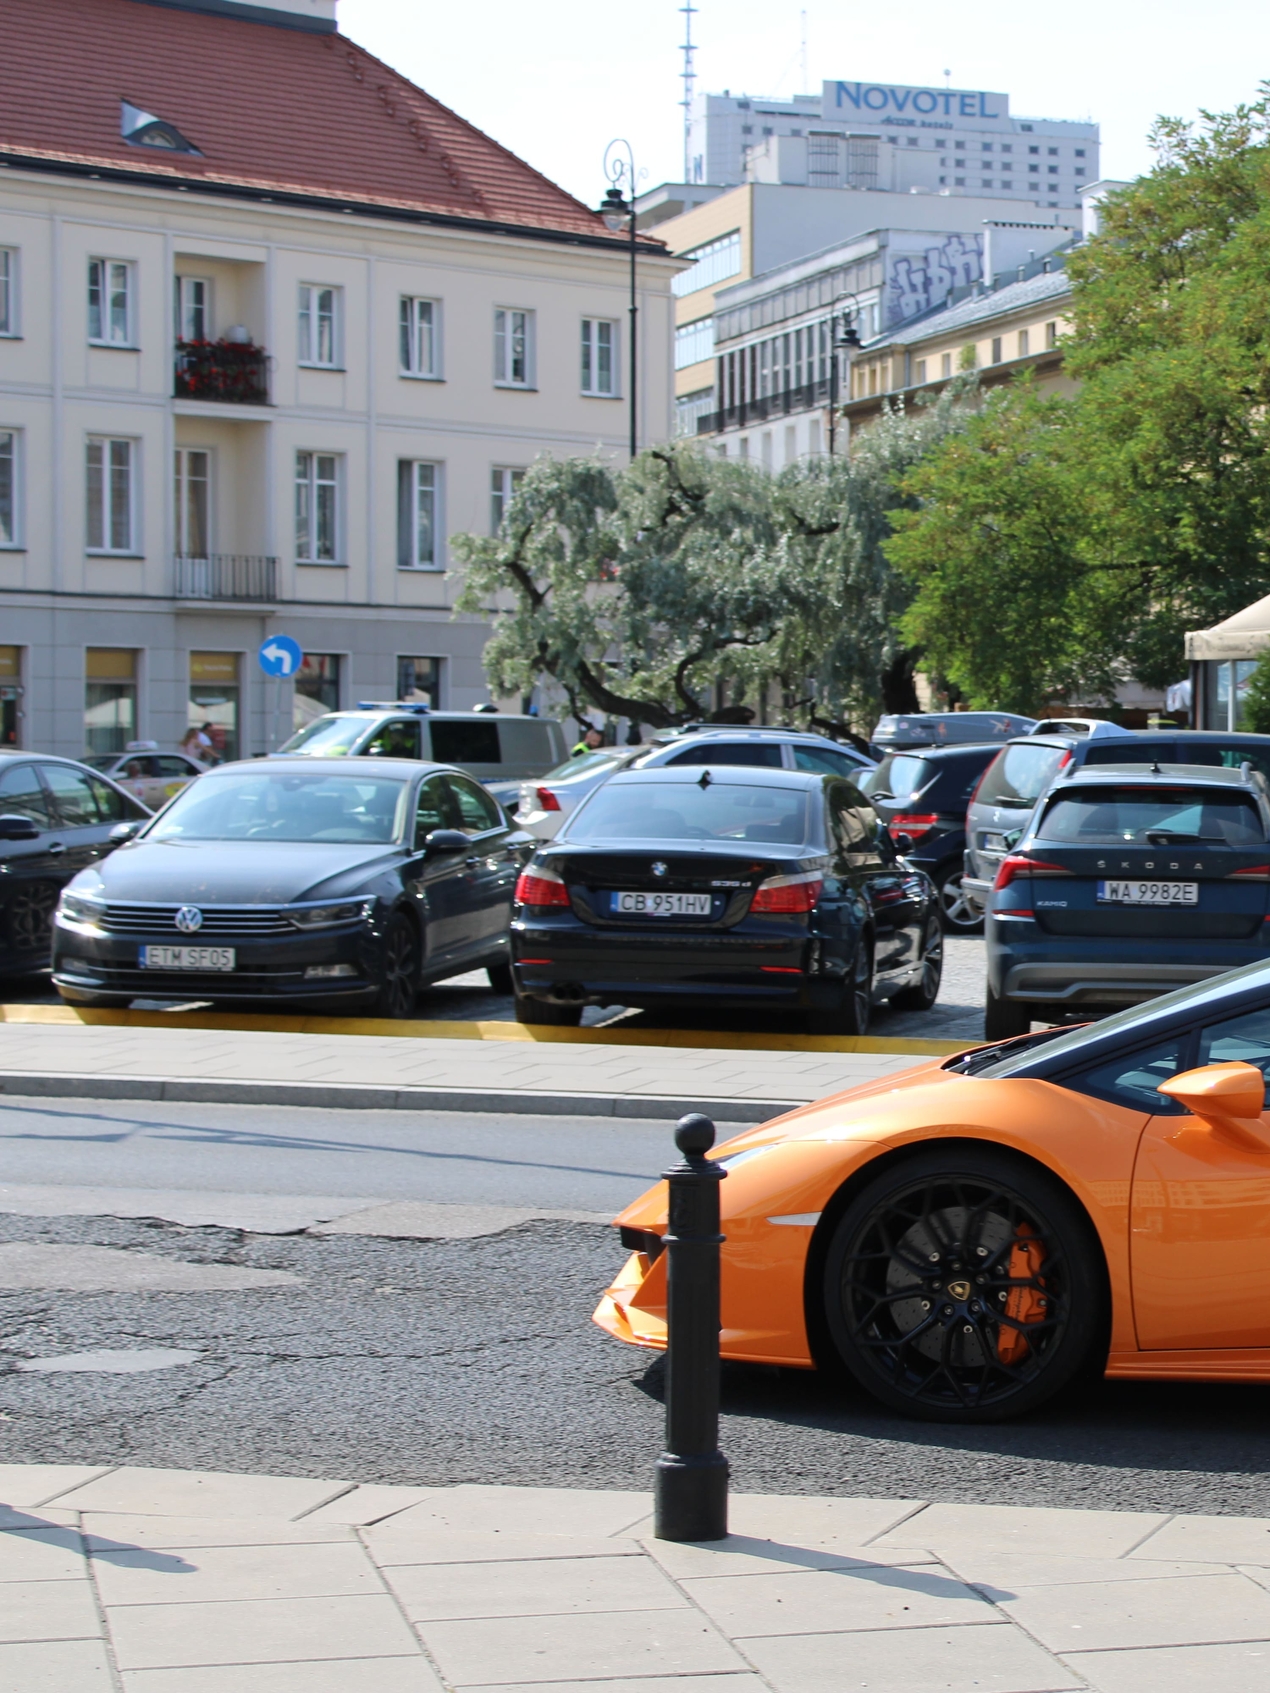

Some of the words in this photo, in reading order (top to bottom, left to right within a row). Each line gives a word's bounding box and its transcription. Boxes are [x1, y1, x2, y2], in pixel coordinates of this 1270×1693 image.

[836, 81, 999, 118] NOVOTEL
[1108, 883, 1132, 900] WA
[1138, 883, 1194, 901] 9982E
[621, 894, 646, 911] CB
[653, 895, 710, 913] 951HV
[148, 947, 182, 965] ETM
[187, 948, 231, 966] SF05
